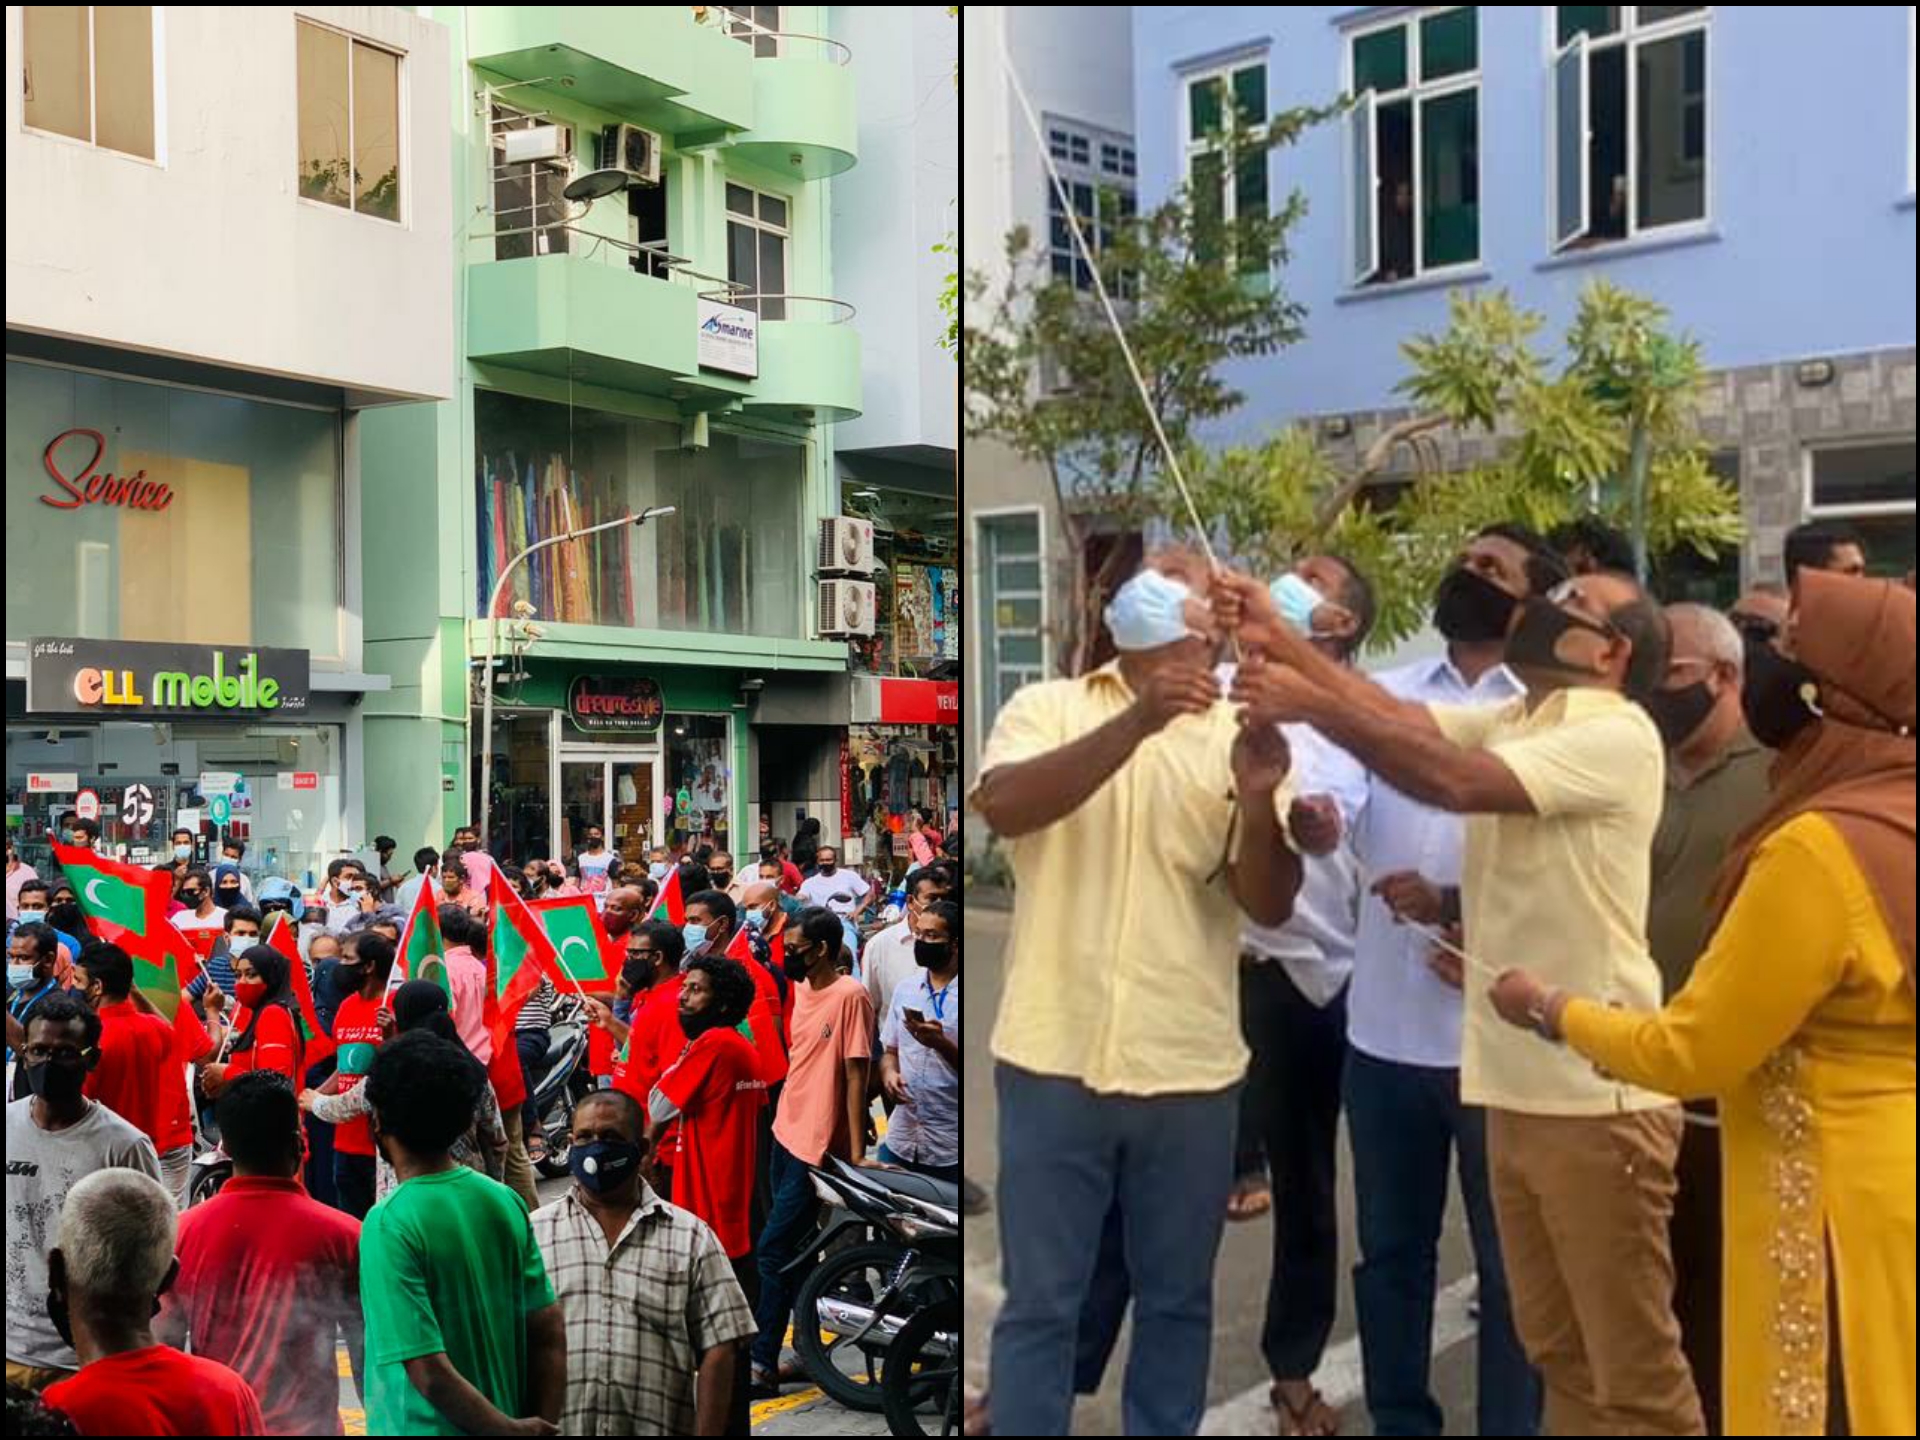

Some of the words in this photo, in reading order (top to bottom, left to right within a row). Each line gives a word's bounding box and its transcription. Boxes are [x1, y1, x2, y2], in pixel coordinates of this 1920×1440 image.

[39, 427, 174, 510] Service
[46, 641, 58, 654] the
[152, 651, 280, 708] mobile
[122, 784, 154, 825] 5G
